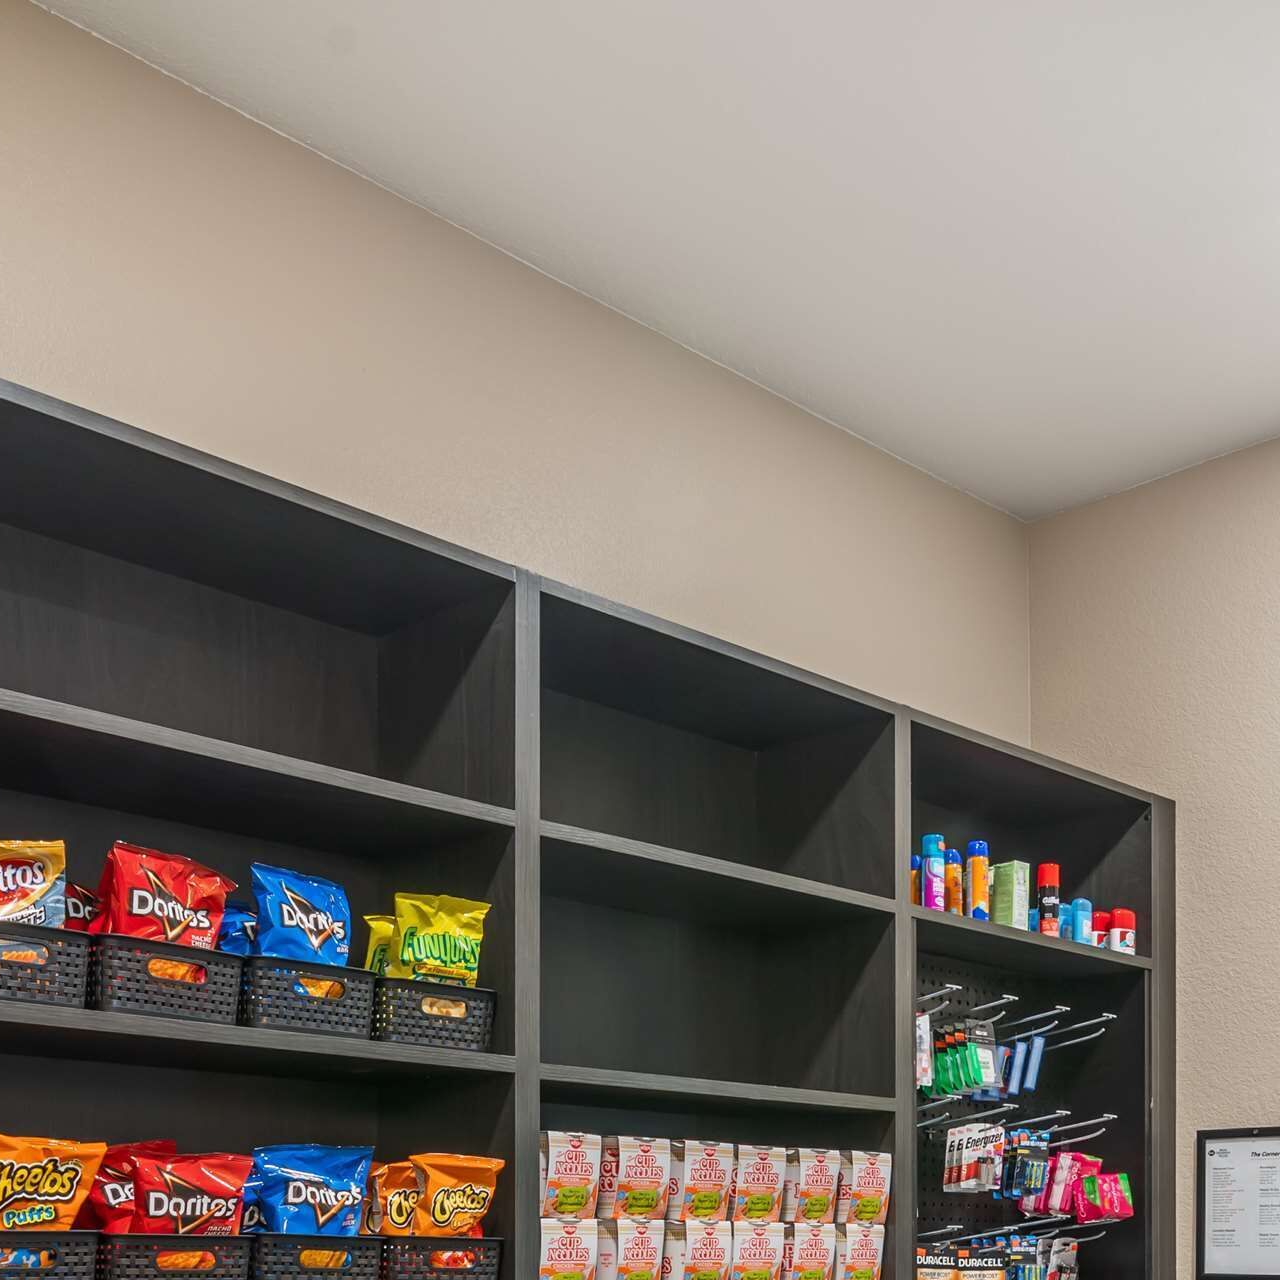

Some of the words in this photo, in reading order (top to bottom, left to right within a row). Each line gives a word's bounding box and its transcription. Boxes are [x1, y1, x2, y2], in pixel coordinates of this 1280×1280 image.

[131, 889, 211, 928] Doritos
[281, 903, 345, 940] Doritos
[965, 1131, 1003, 1150] Energizer
[565, 1150, 586, 1163] CUP
[635, 1154, 656, 1167] CUP
[555, 1163, 593, 1176] NOODLES
[699, 1158, 719, 1170] CUP
[753, 1162, 773, 1174] CUP
[812, 1165, 829, 1175] CUP
[625, 1166, 663, 1179] NOODLES
[691, 1169, 725, 1182] NOODLES
[864, 1167, 880, 1177] CUP
[744, 1173, 779, 1185] NOODLES
[805, 1174, 834, 1186] NOODLES
[857, 1176, 885, 1188] NOODLES
[288, 1181, 362, 1206] Doritos
[149, 1190, 237, 1218] Doritos
[432, 1186, 489, 1226] Cheetos
[4, 1206, 55, 1228] Puffs
[558, 1237, 582, 1249] CUP
[632, 1237, 652, 1249] CUP
[699, 1237, 719, 1249] CUP
[749, 1238, 769, 1249] CUP
[807, 1239, 824, 1249] CUP
[858, 1239, 873, 1249] CUP
[547, 1248, 589, 1261] NOODLES
[623, 1248, 661, 1260] NOODLES
[691, 1248, 724, 1260] NOODLES
[740, 1248, 775, 1260] NOODLES
[799, 1248, 828, 1260] NOODLES
[851, 1248, 879, 1260] NOODLES
[917, 1256, 955, 1266] DURACELL
[959, 1258, 1003, 1268] DURACELL
